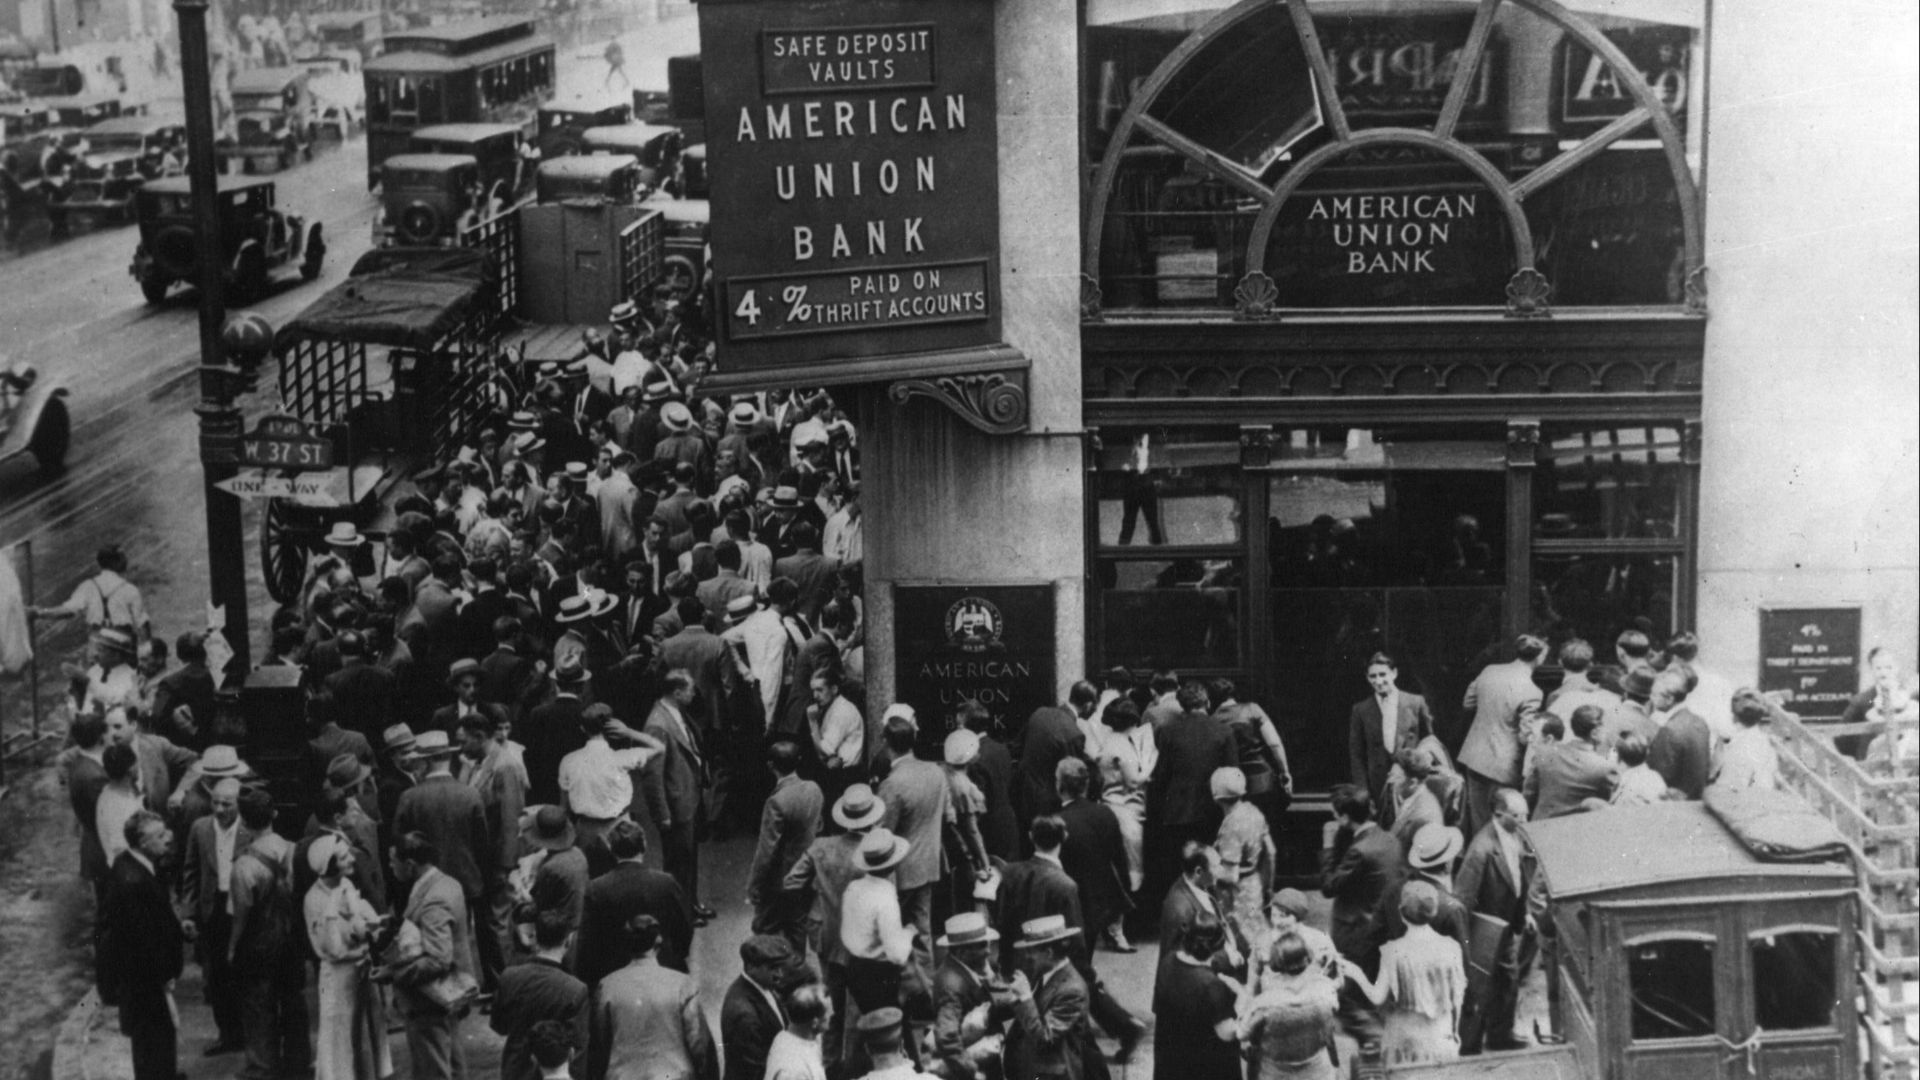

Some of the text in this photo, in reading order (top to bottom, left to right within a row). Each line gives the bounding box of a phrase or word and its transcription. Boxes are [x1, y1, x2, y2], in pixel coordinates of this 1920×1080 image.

[774, 31, 929, 57] SAFE DEPOSIT
[809, 59, 895, 81] VAULTS
[737, 94, 967, 142] AMERICAN
[775, 157, 935, 200] UNION
[1309, 195, 1477, 220] AMERICAN
[793, 218, 924, 260] BANK
[1333, 223, 1450, 247] UNION
[1347, 250, 1436, 274] BANK
[850, 271, 941, 295] PAID ON
[735, 289, 761, 325] 4
[815, 291, 985, 323] THRIFT ACCOUNTS
[268, 442, 290, 462] 37
[232, 482, 265, 492] ONE
[286, 484, 319, 494] WAY
[1791, 645, 1813, 653] PAID
[920, 662, 1030, 678] AMERICAN
[1766, 657, 1853, 666] THRIFT DEPARTMENT
[940, 688, 1009, 703] UNION
[946, 715, 1006, 729] BK
